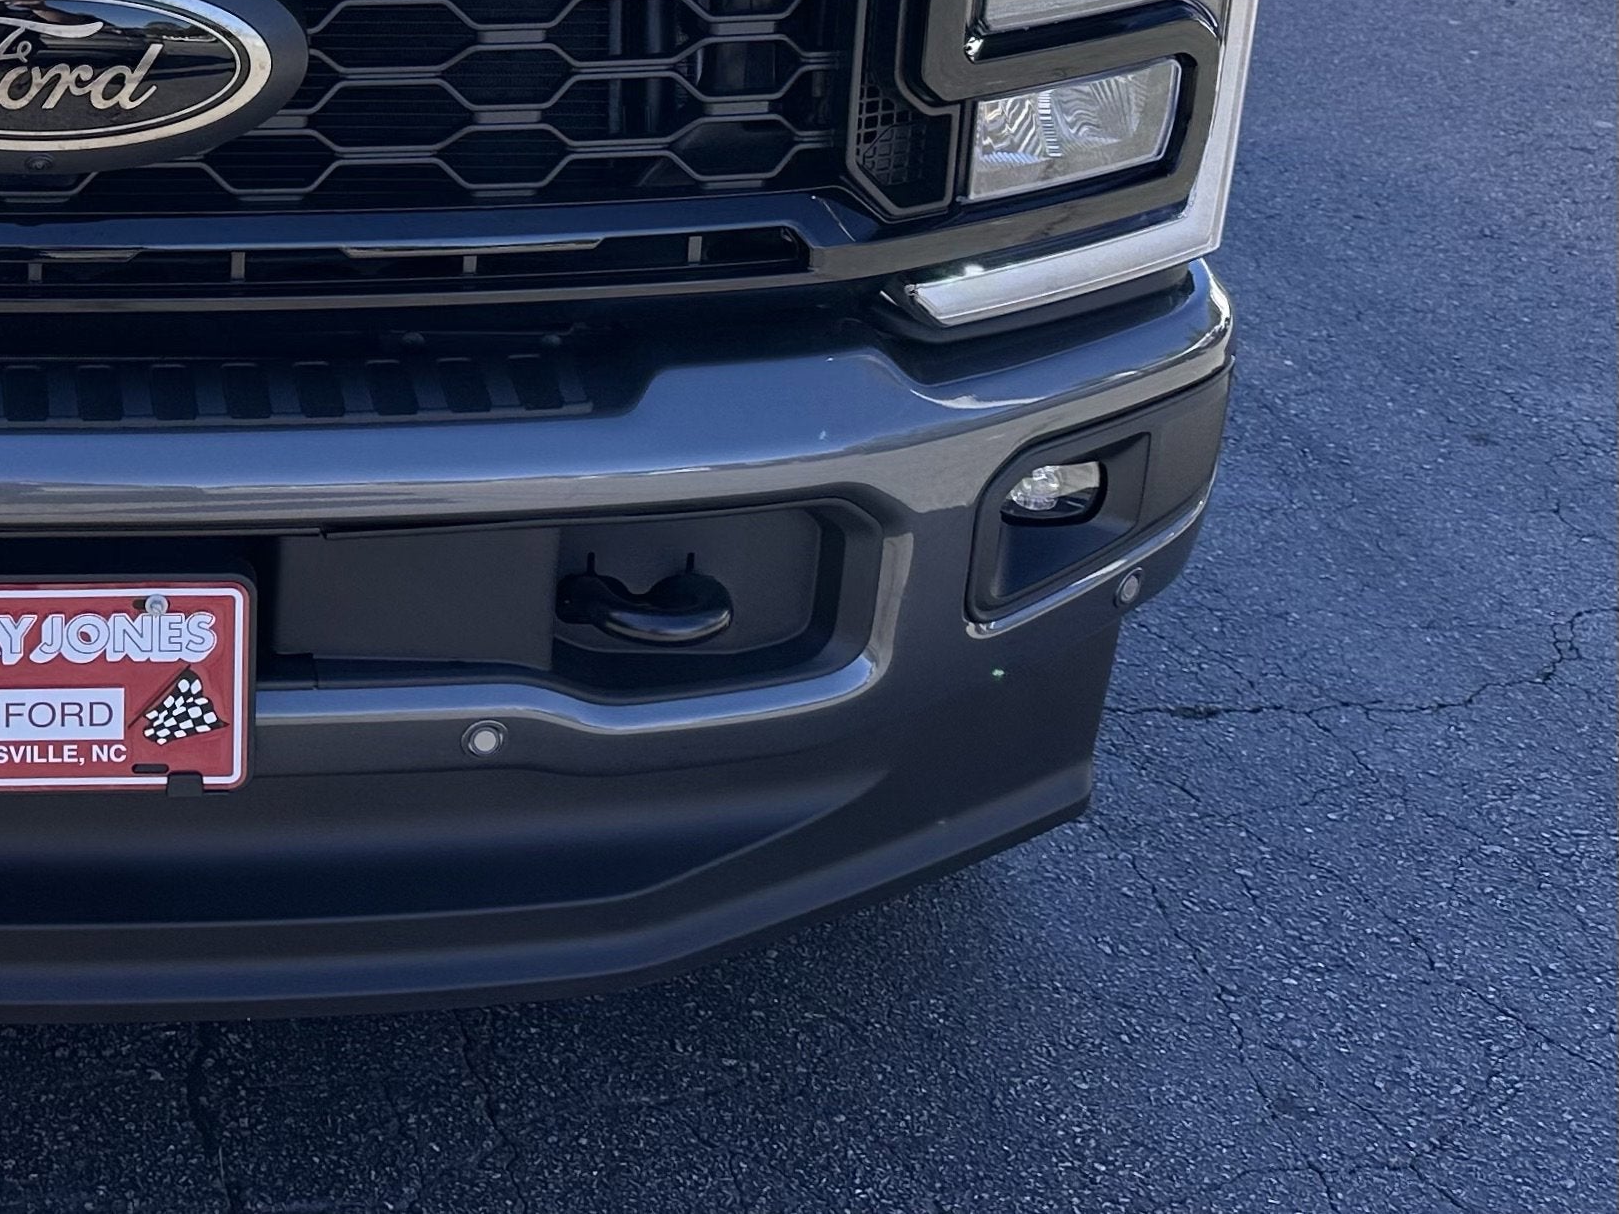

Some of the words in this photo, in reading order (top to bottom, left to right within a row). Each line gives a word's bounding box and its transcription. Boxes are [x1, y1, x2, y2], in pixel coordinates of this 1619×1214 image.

[29, 611, 217, 666] JONES
[4, 701, 114, 728] FORD
[91, 744, 128, 763] NC
